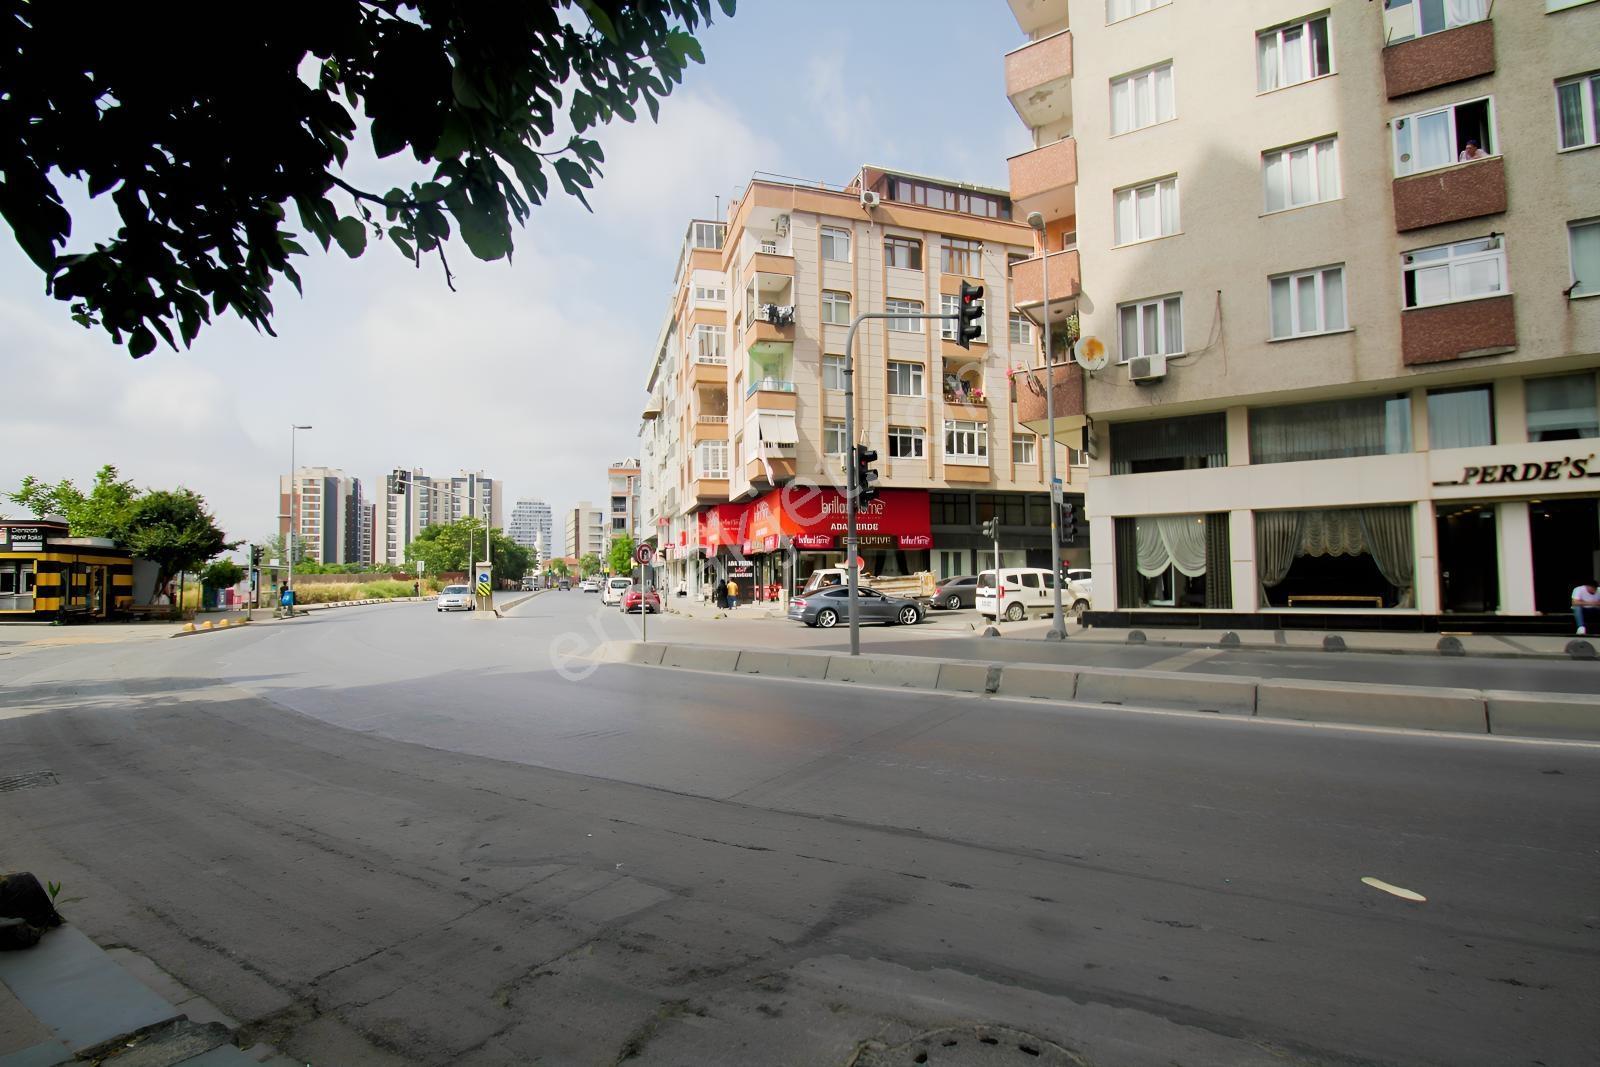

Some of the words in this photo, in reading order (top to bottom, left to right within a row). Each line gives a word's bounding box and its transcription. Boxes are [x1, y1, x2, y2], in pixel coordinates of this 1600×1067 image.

[1461, 456, 1588, 486] PERDE'S
[830, 523, 848, 531] ADA
[850, 523, 879, 531] ERDE
[842, 536, 891, 545] ELUSIVE
